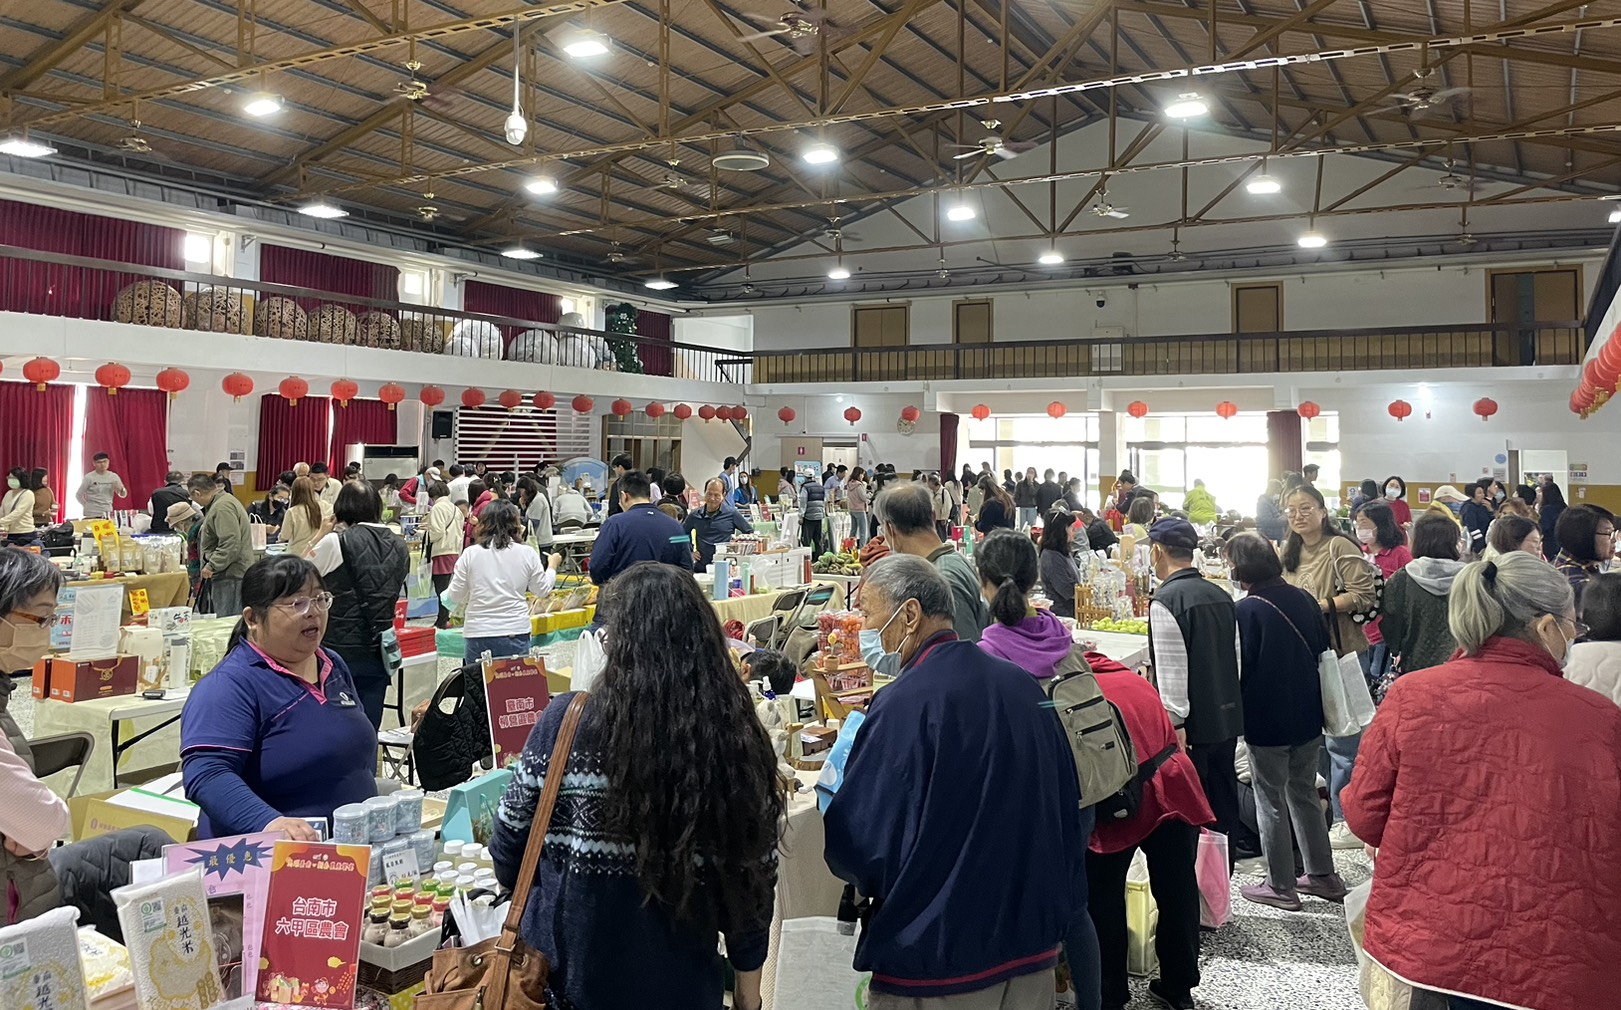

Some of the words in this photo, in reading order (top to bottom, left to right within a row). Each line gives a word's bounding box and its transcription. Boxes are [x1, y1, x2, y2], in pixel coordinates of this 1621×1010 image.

[209, 851, 252, 867] 最優惠
[292, 896, 337, 917] 台南市
[177, 915, 194, 954] 越光米
[275, 917, 349, 939] 六甲區農會
[36, 984, 53, 1010] 越光
